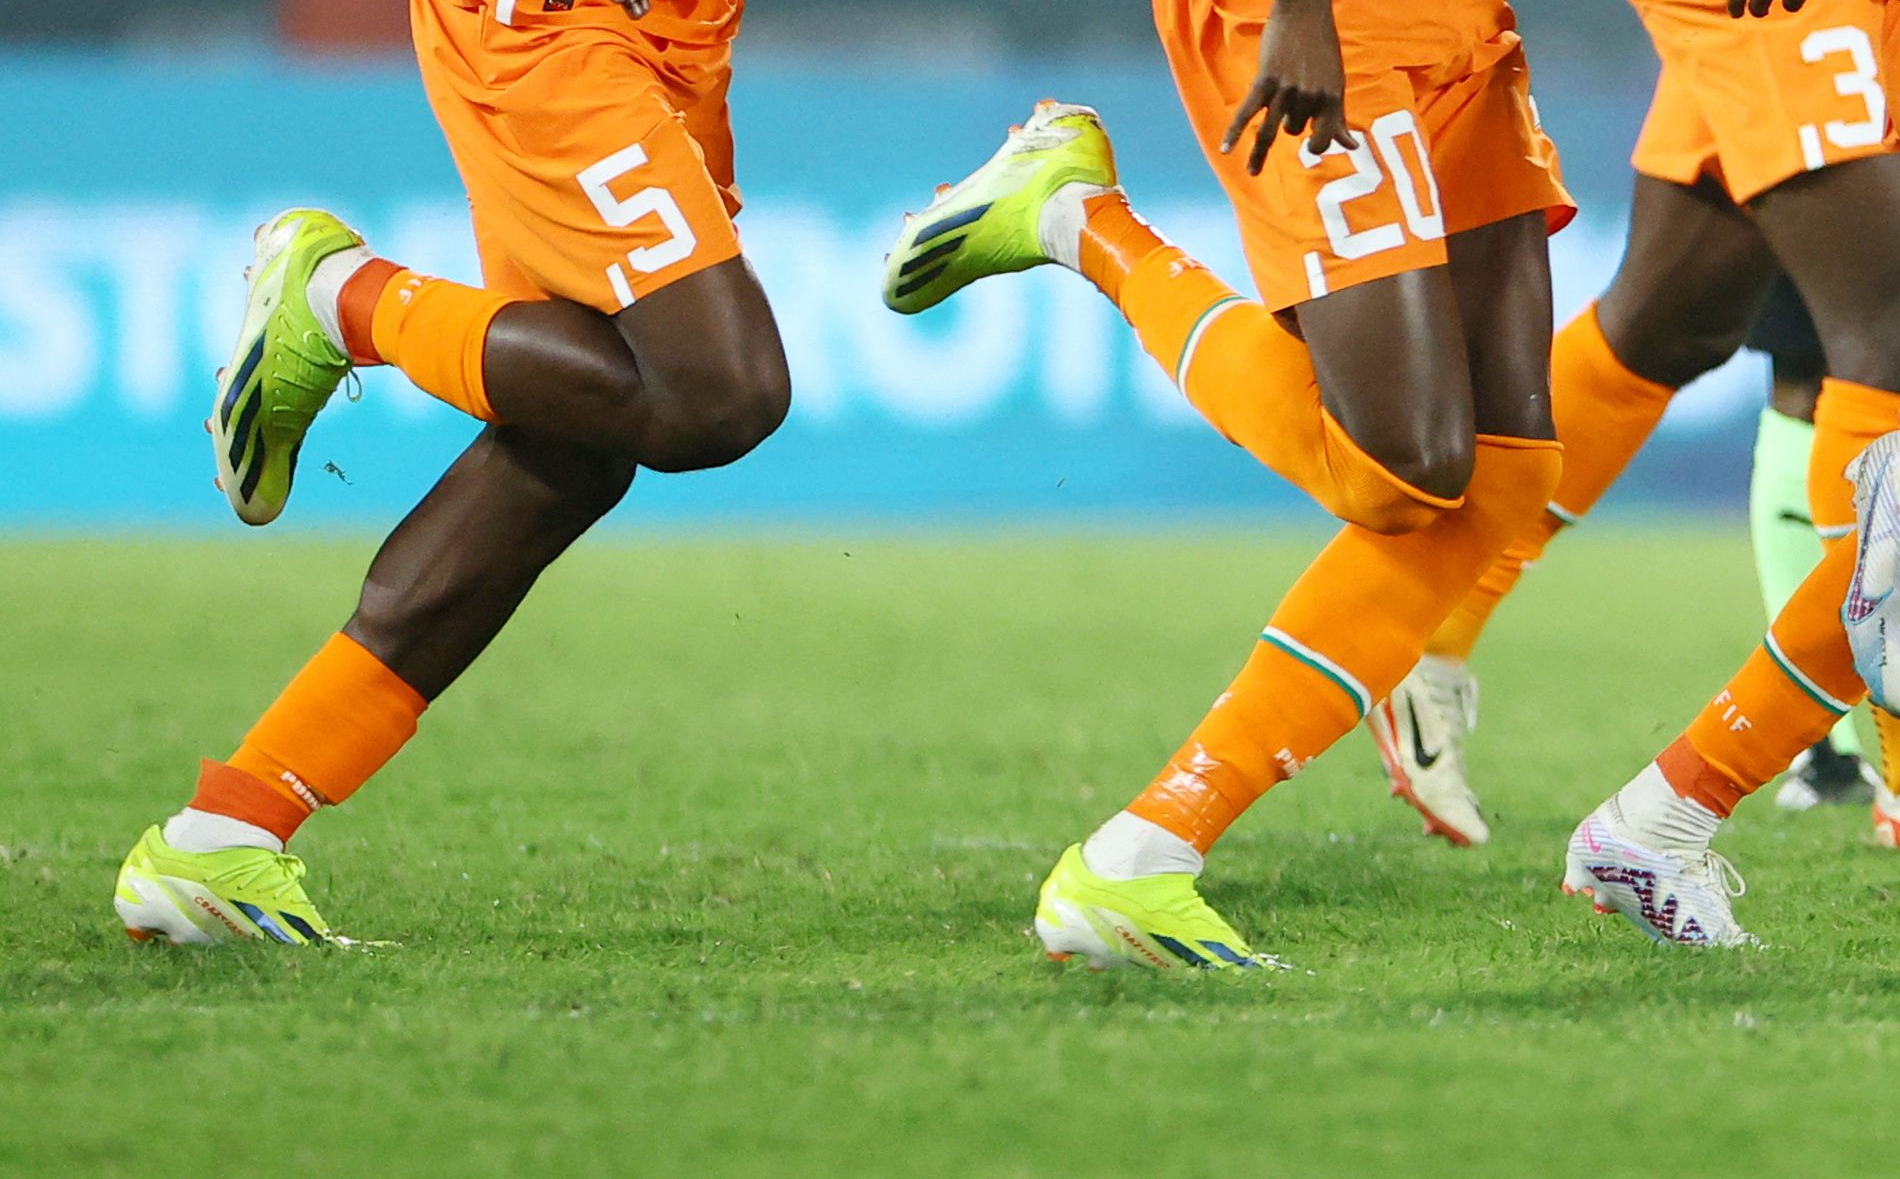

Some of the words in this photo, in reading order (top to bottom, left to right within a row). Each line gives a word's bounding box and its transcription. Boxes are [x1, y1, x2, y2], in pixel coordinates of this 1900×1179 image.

[1800, 25, 1886, 149] 3
[575, 141, 698, 274] 5
[1297, 108, 1446, 261] 20
[1711, 688, 1753, 732] FIF
